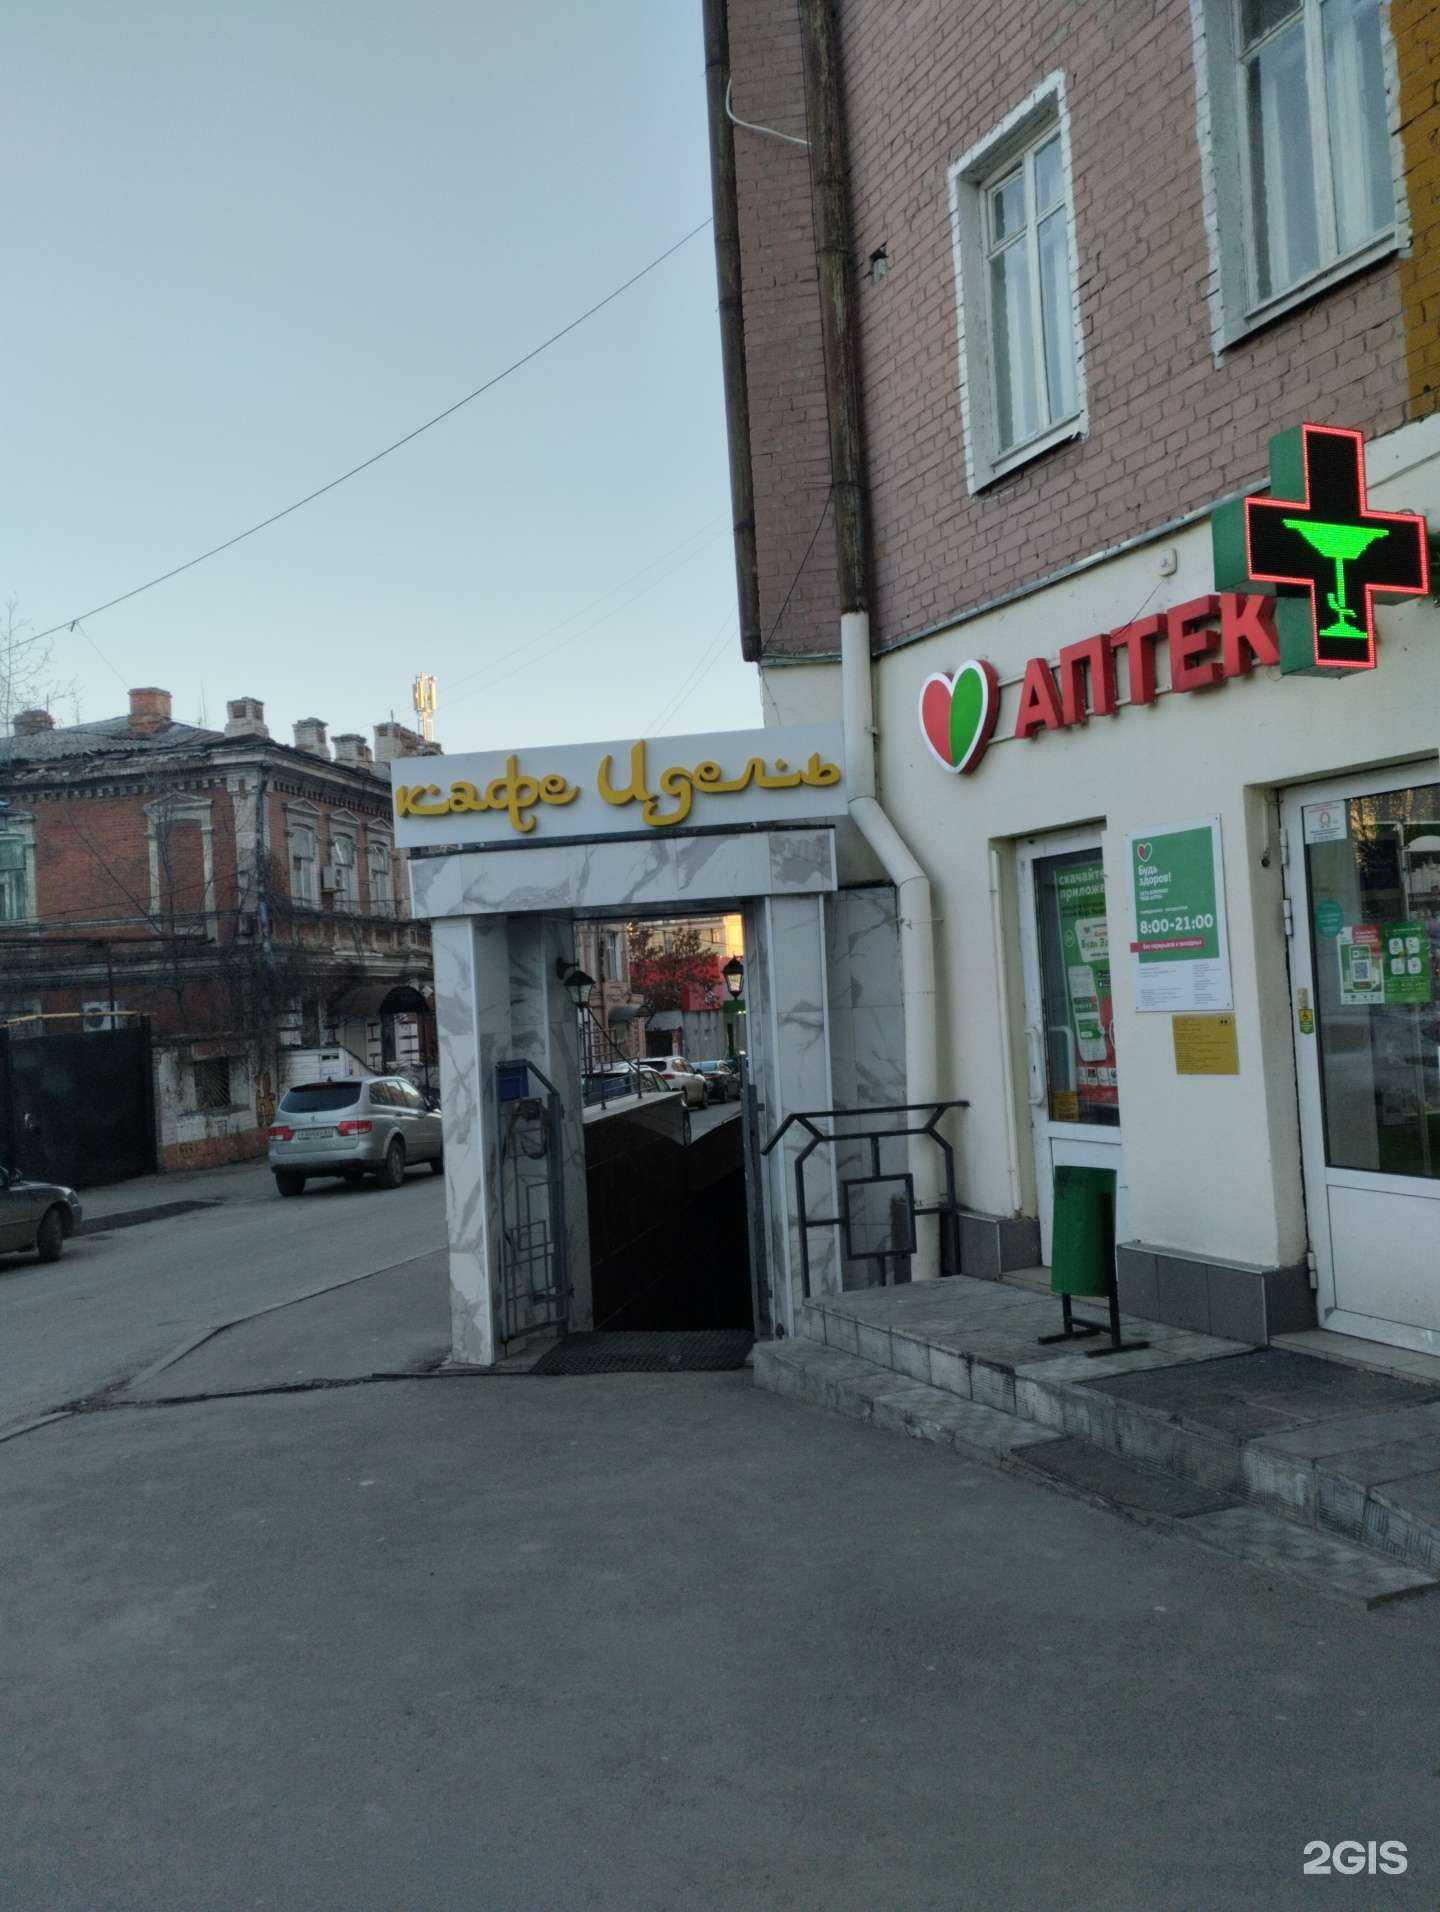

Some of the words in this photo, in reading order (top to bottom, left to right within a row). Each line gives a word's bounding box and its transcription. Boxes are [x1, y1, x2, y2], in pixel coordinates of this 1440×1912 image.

[395, 754, 581, 832] кафе
[597, 739, 841, 826] Идель
[1140, 913, 1214, 934] 8:00-21:00
